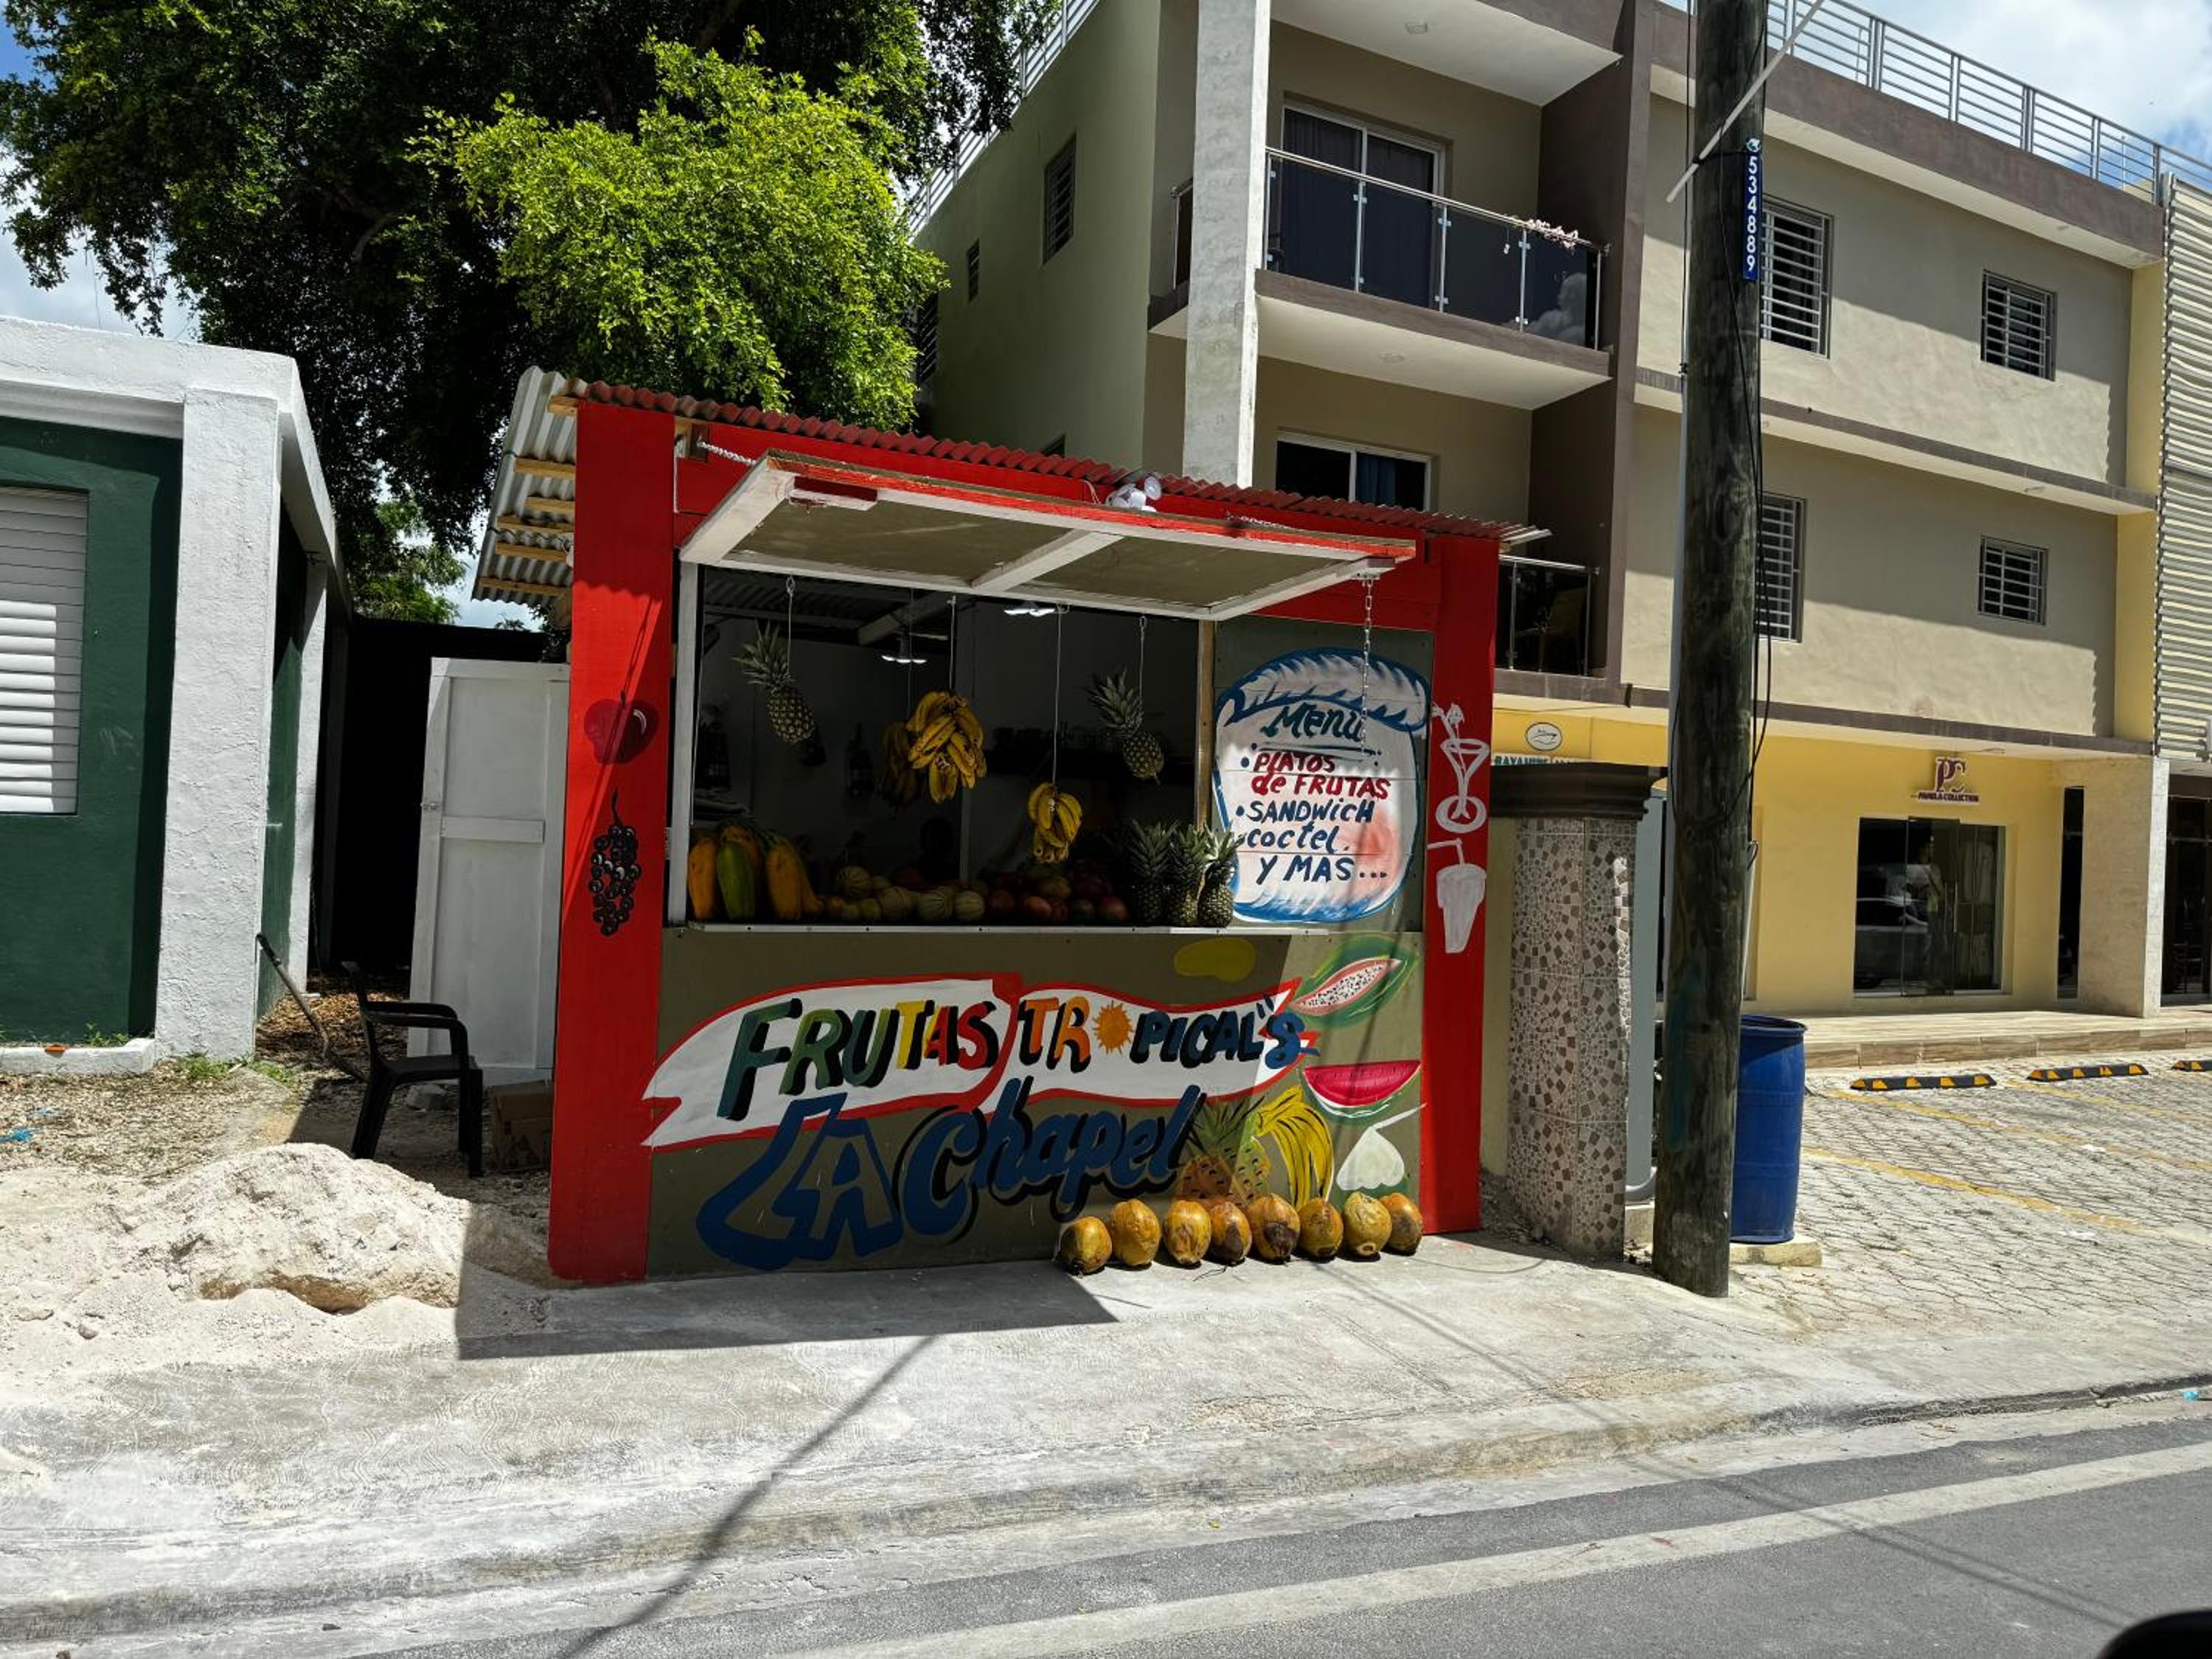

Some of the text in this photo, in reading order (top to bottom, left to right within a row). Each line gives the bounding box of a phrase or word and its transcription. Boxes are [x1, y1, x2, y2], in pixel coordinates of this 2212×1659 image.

[1746, 156, 1758, 271] 534889
[1251, 772, 1391, 800] de FRUTAS
[1944, 793, 1979, 802] COLLECTION
[717, 998, 998, 1121] FRUTAS
[893, 1075, 1208, 1246] Chapel
